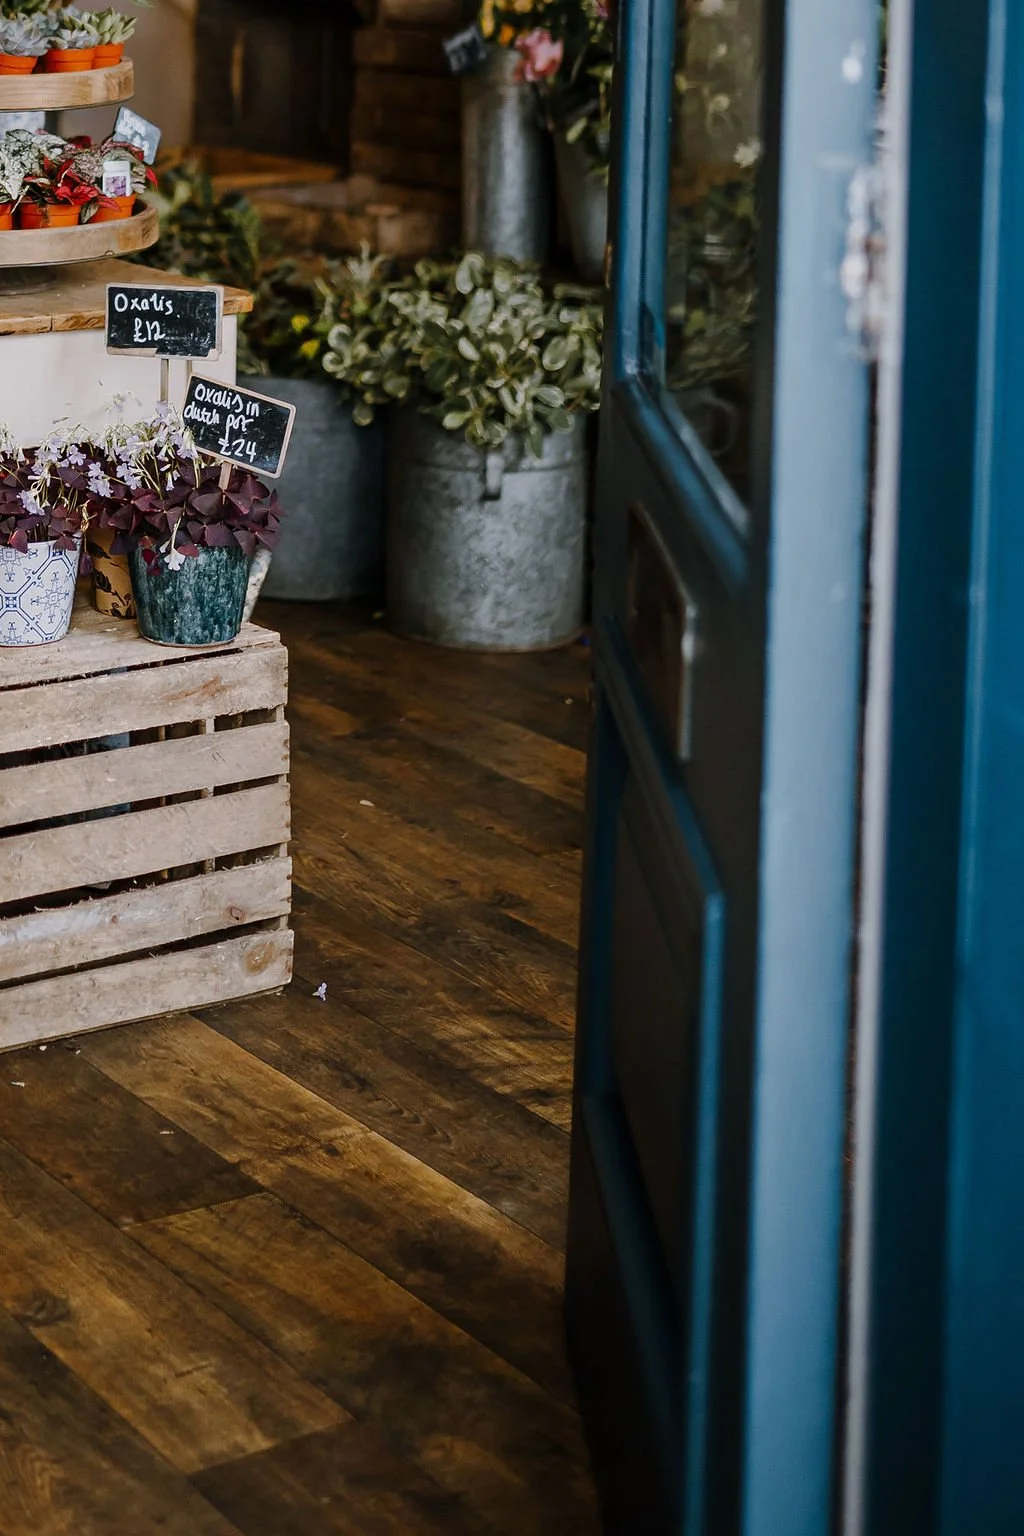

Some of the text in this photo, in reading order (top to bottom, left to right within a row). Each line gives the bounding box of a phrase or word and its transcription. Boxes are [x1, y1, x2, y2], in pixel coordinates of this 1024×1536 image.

[114, 293, 174, 315] Oxalis
[133, 317, 166, 343] £12
[183, 401, 220, 425] dutch
[194, 383, 260, 417] Oxalis in
[217, 436, 257, 463] £24
